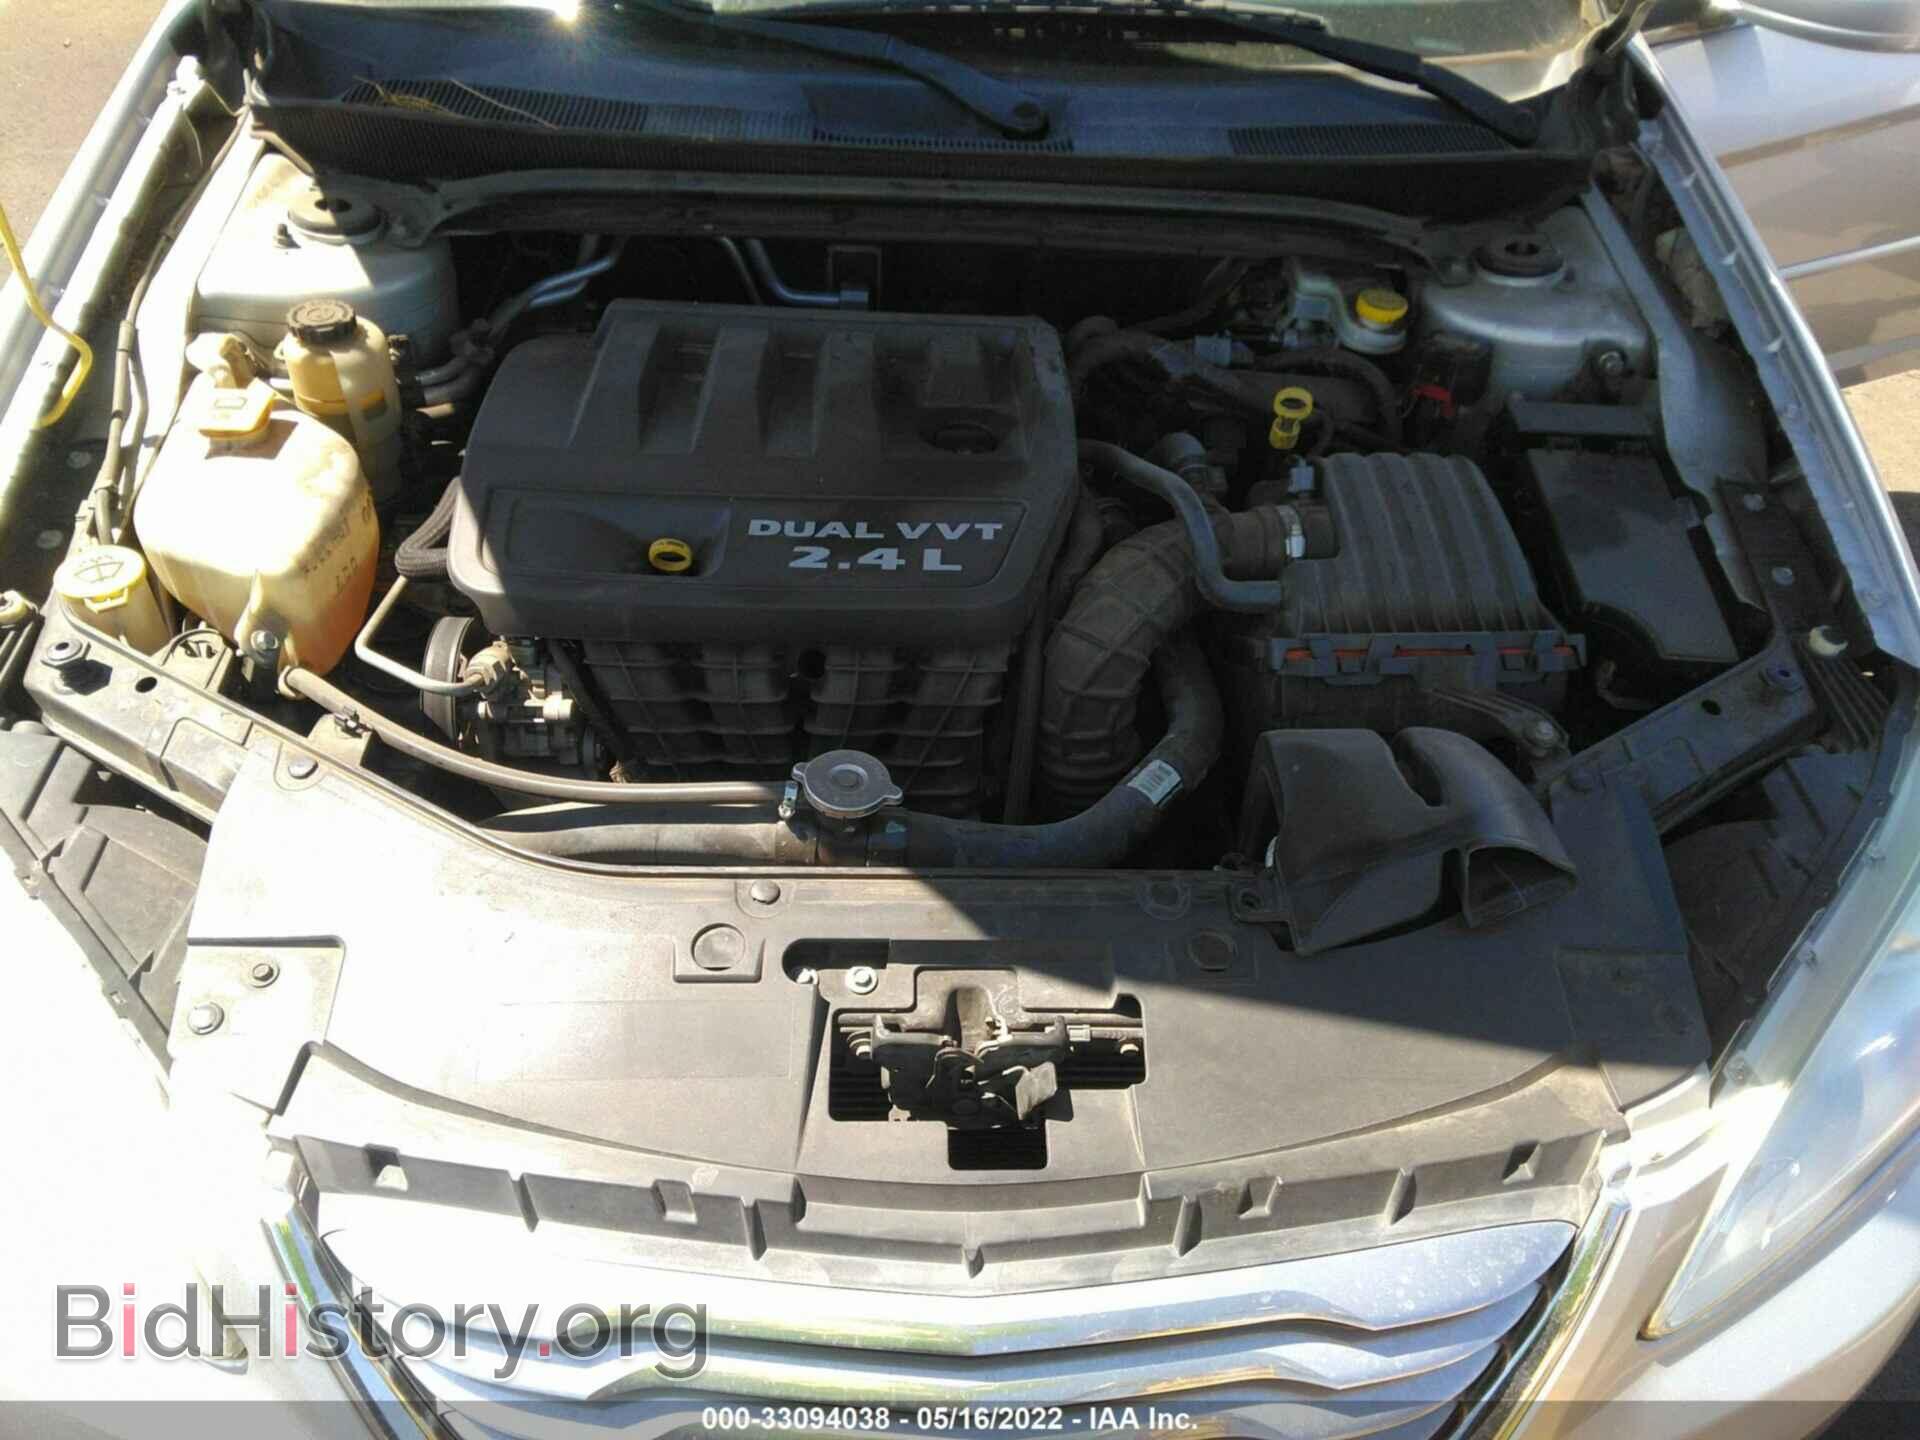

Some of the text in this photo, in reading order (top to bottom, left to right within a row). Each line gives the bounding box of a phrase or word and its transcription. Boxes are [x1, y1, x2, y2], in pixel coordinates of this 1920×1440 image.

[748, 519, 1003, 540] DUAL VVT
[788, 546, 963, 571] 2.4 L
